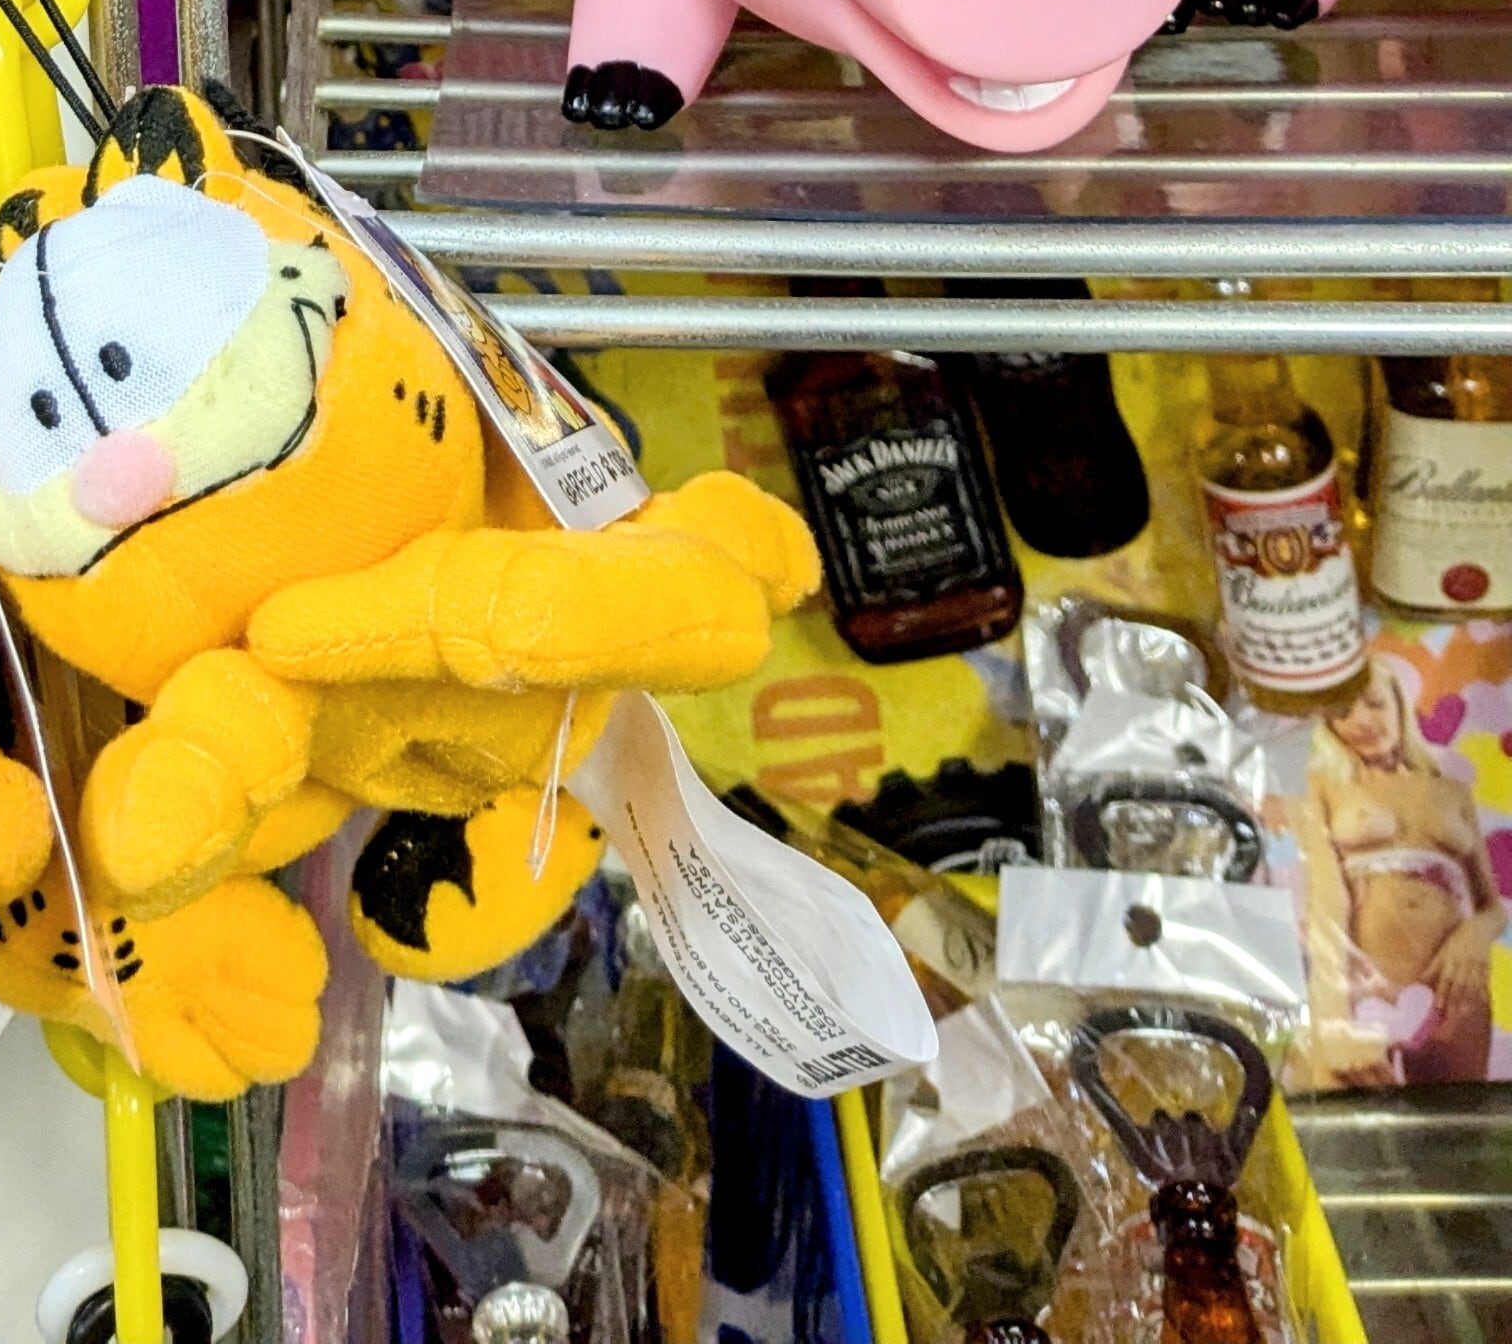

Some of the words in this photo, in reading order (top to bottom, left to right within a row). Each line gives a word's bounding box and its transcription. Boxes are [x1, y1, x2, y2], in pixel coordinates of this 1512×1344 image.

[669, 839, 703, 900] CHINA
[702, 902, 720, 920] IN
[720, 921, 828, 1042] HANDCRAFTED
[705, 999, 743, 1034] NEW
[744, 1033, 774, 1058] ALL
